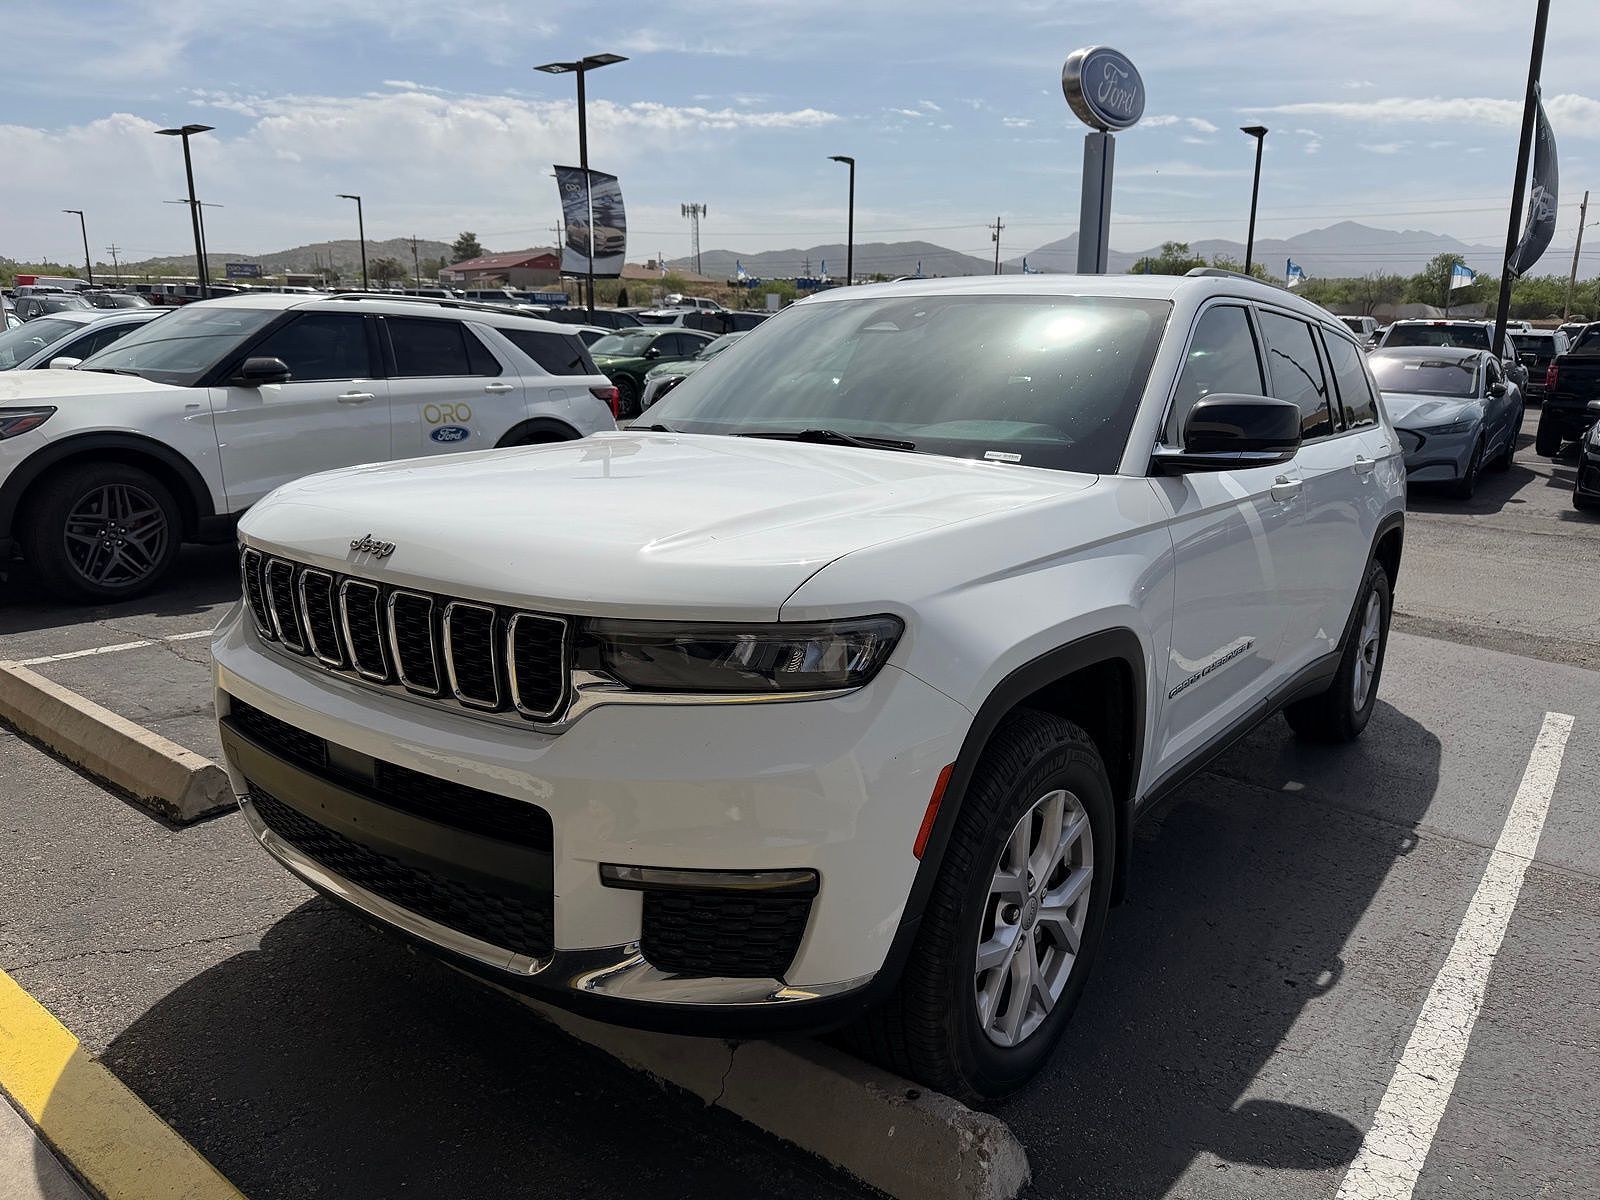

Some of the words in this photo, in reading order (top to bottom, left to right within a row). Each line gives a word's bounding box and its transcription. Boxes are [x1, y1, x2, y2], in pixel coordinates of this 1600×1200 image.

[1098, 62, 1137, 113] Ford
[424, 403, 472, 424] ORO
[437, 428, 463, 441] Ford
[350, 534, 396, 559] Jeep
